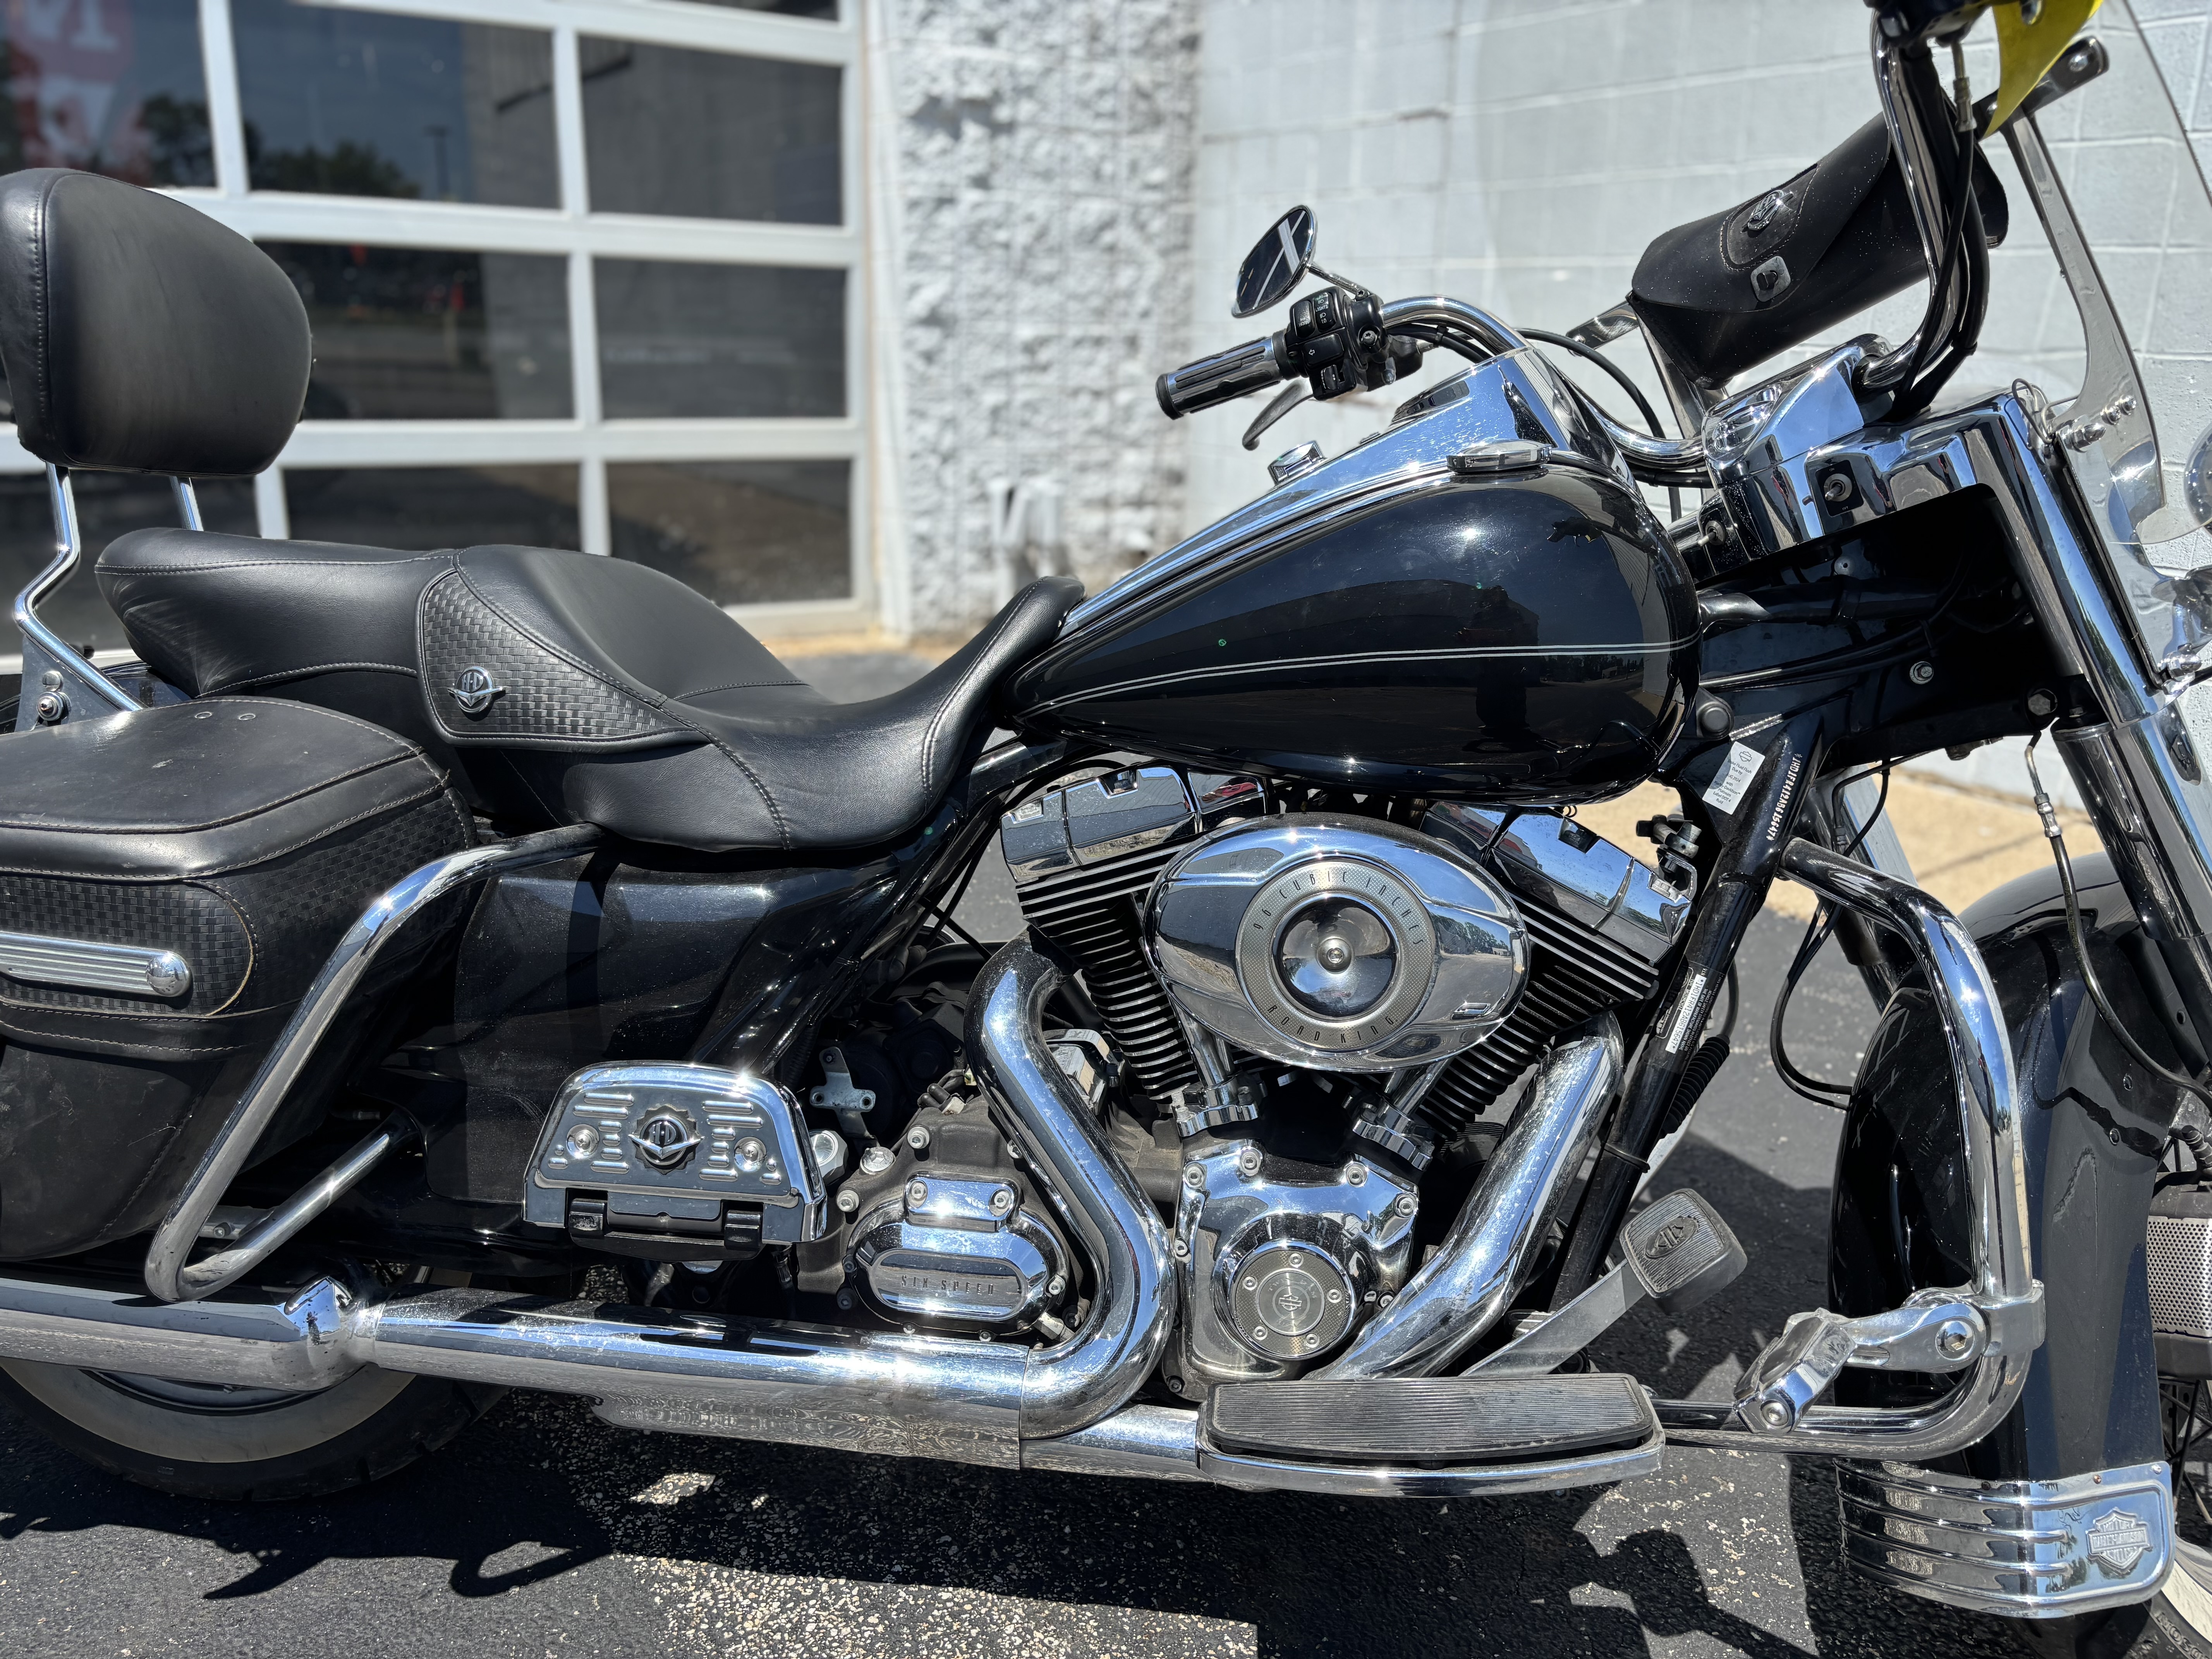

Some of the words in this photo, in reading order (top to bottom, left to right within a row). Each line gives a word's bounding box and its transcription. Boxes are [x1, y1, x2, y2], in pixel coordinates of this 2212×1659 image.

[1254, 908, 1271, 930] 96
[1279, 871, 1346, 898] CUBIC
[1366, 878, 1424, 944] INCHES
[1267, 1005, 1320, 1041] ROAD
[1341, 1017, 1394, 1043] KING
[902, 1275, 929, 1288] SIX
[941, 1280, 994, 1295] SPEED
